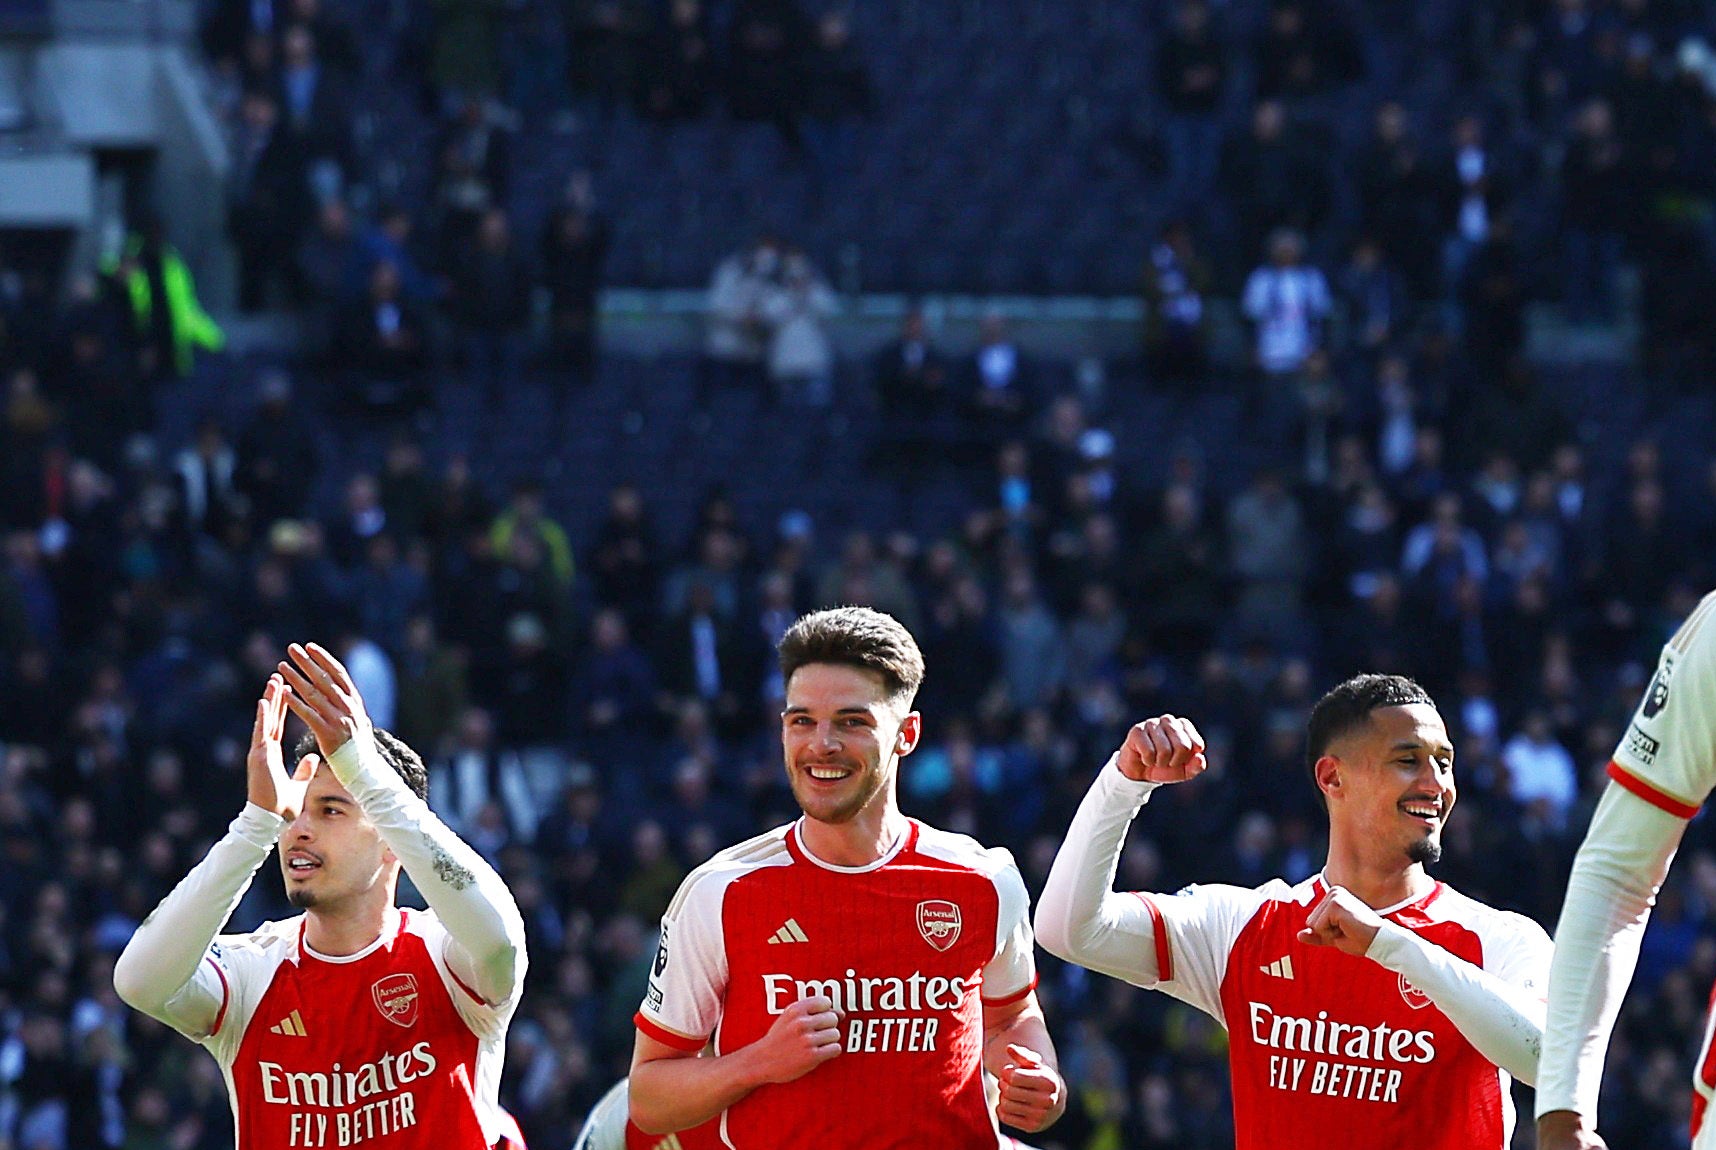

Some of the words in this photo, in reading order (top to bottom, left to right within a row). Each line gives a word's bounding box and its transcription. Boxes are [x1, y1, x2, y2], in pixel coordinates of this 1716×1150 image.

[922, 908, 956, 919] Arsenal
[761, 968, 966, 1015] Emirates
[846, 1018, 939, 1053] BETTER
[1248, 1001, 1437, 1064] Emirates
[258, 1041, 437, 1108] Emirates
[1269, 1055, 1306, 1091] FLY
[1310, 1061, 1403, 1103] BETTER
[289, 1113, 327, 1148] FLY
[336, 1091, 417, 1148] BETTER
